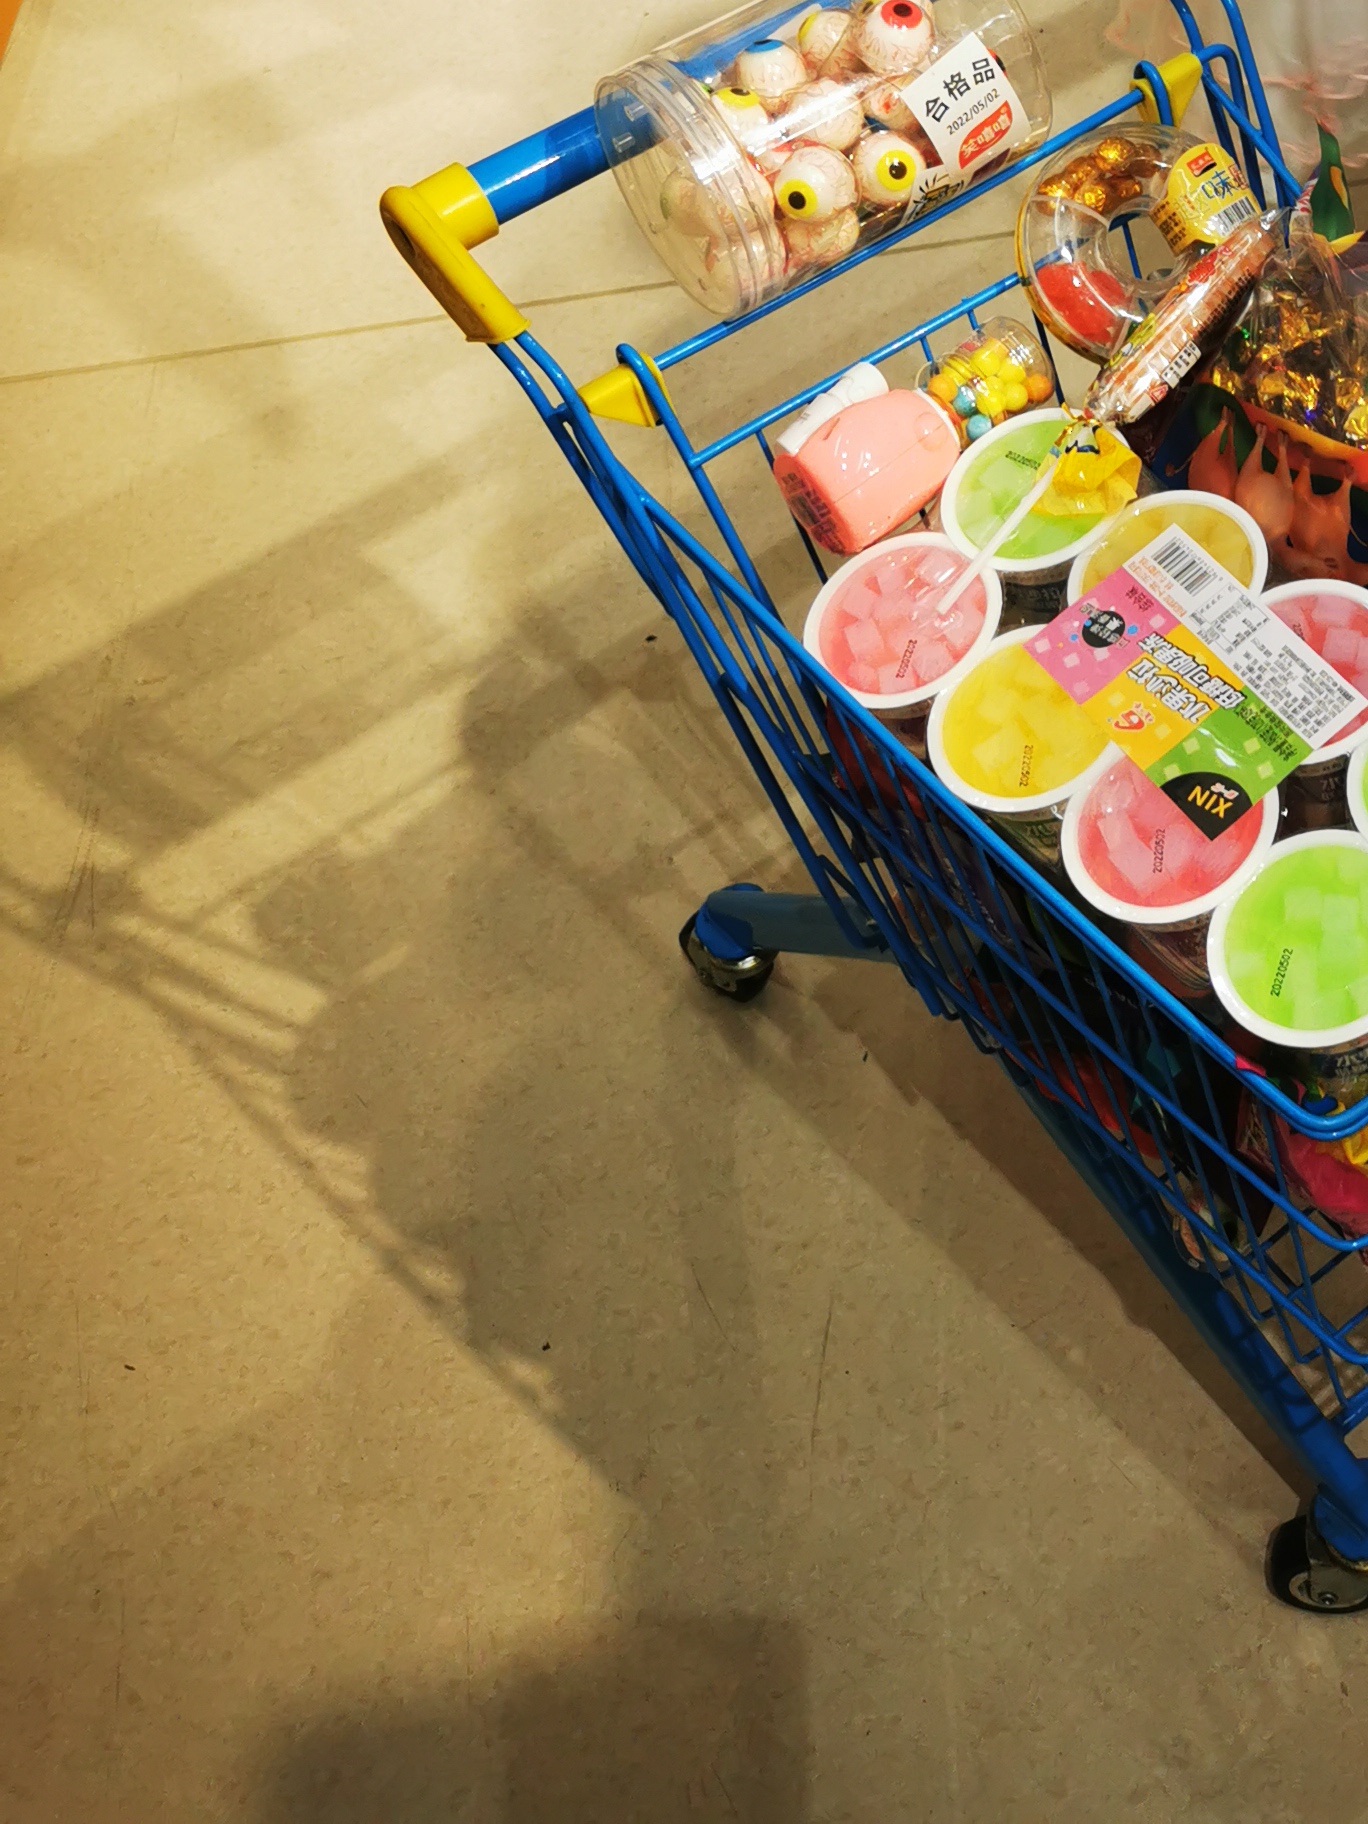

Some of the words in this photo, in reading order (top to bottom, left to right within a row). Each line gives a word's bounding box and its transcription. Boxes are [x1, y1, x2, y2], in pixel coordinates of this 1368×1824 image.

[925, 57, 996, 123] 合格品
[946, 88, 1001, 136] 2022/05/02
[1126, 657, 1212, 724] 水果沙拉
[1018, 742, 1035, 788] 20220502
[1188, 784, 1230, 819] XIN
[1152, 827, 1167, 874] 20220502
[1269, 946, 1294, 998] 20220502
